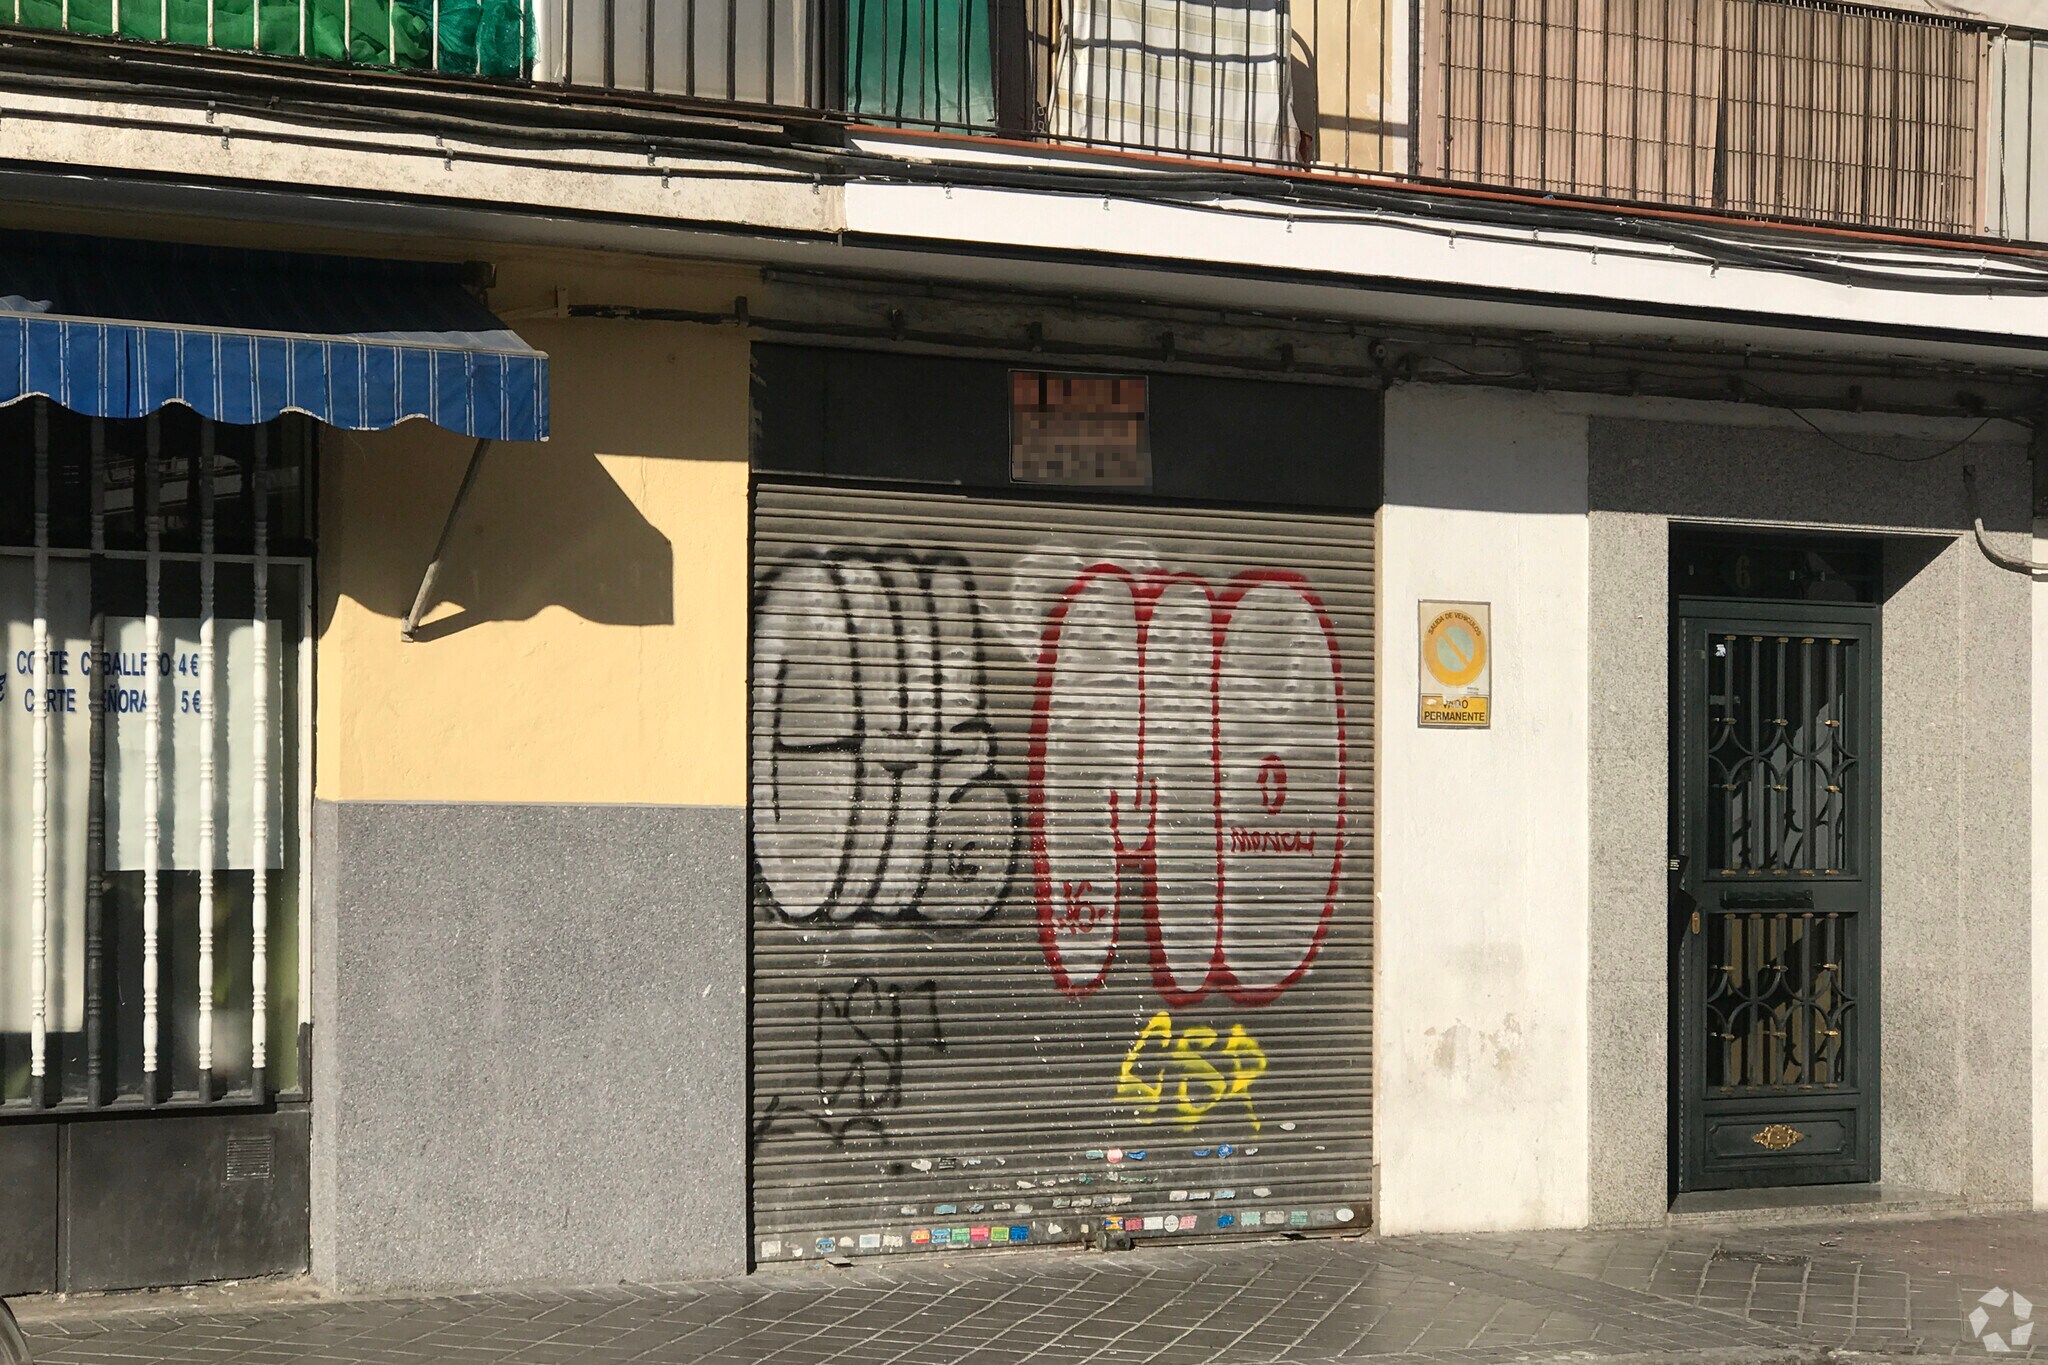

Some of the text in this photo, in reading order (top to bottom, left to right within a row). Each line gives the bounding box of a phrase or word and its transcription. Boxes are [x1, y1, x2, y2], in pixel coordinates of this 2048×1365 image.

[1428, 615, 1444, 635] SALIDA
[17, 650, 69, 675] COTE
[81, 651, 170, 676] CBALLEO
[25, 688, 76, 712] CRTE
[97, 684, 147, 713] ÑORA
[1424, 711, 1485, 721] PERMANENTE
